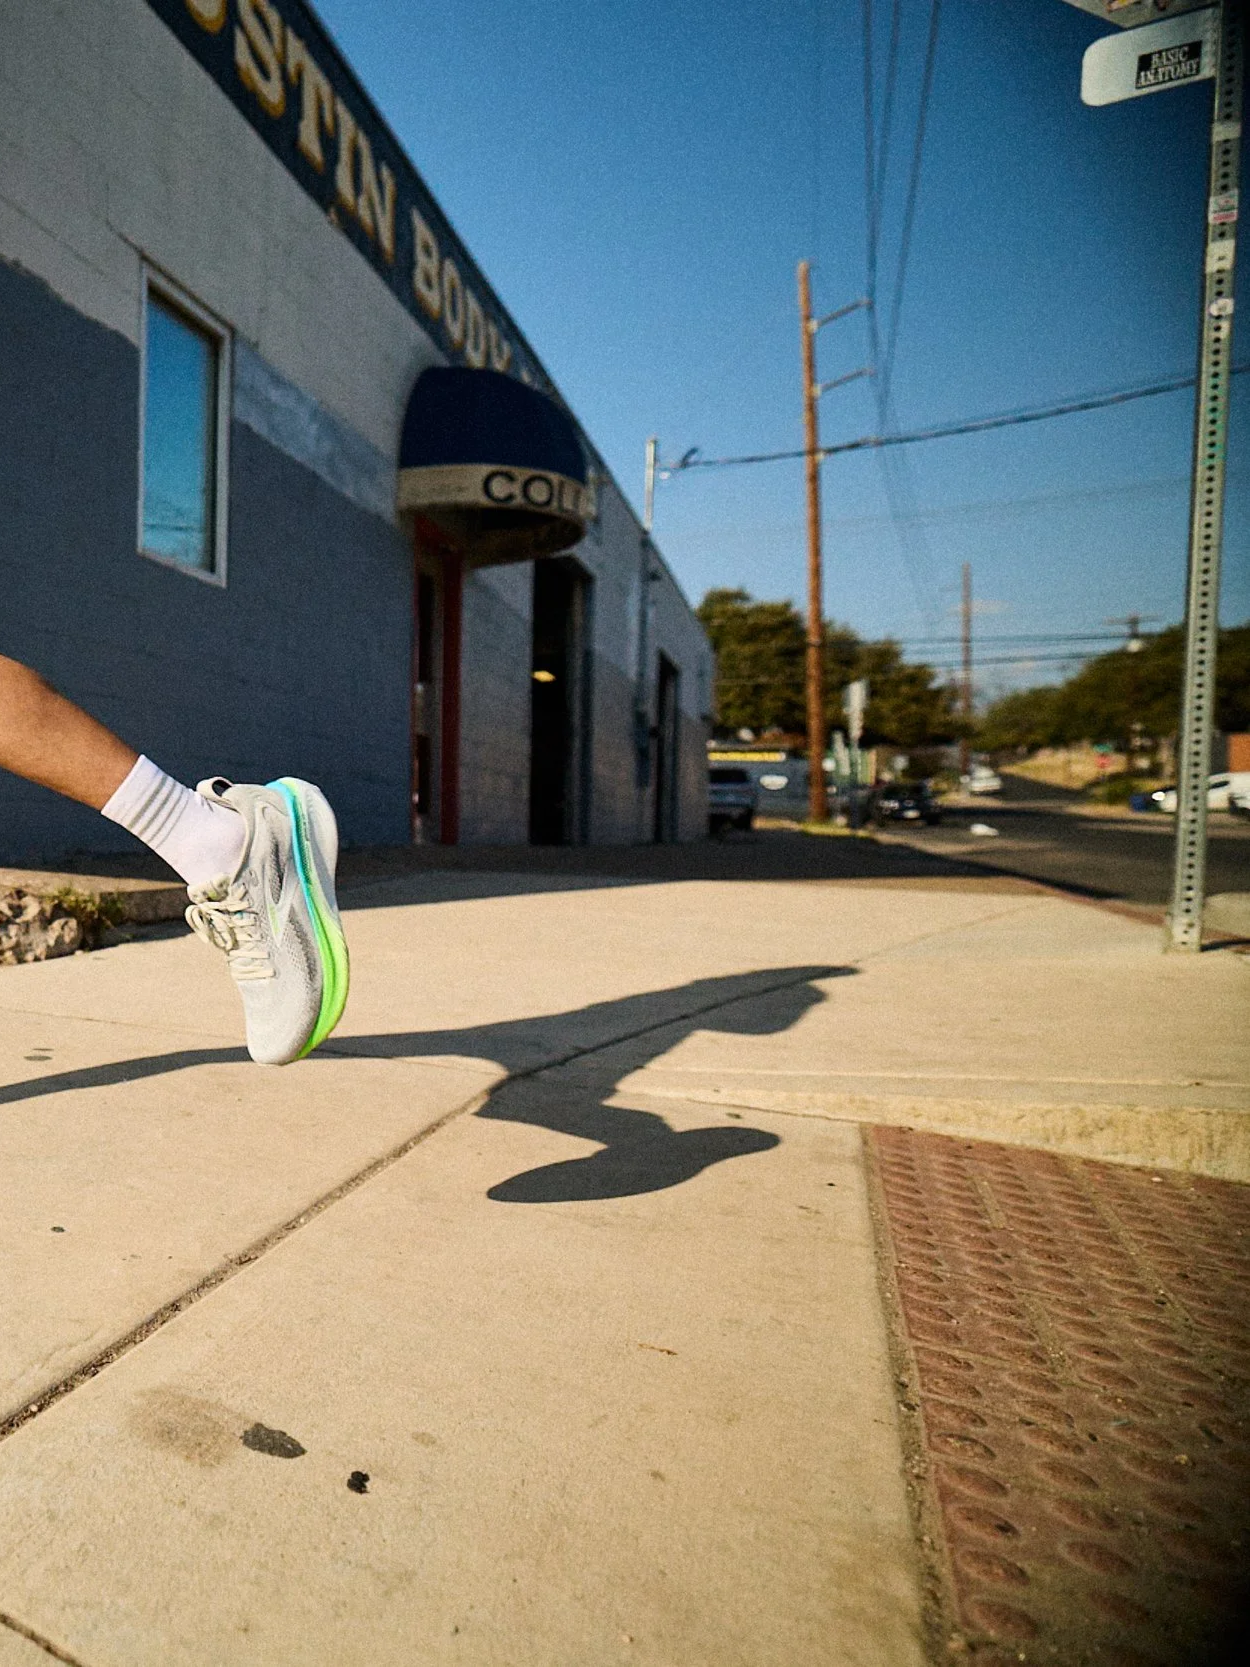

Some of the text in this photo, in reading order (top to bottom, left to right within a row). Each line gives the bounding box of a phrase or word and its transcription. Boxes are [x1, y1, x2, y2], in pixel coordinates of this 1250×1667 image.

[1137, 57, 1200, 87] ANATOMY
[1151, 46, 1189, 69] BASIC
[184, 0, 398, 265] STIN
